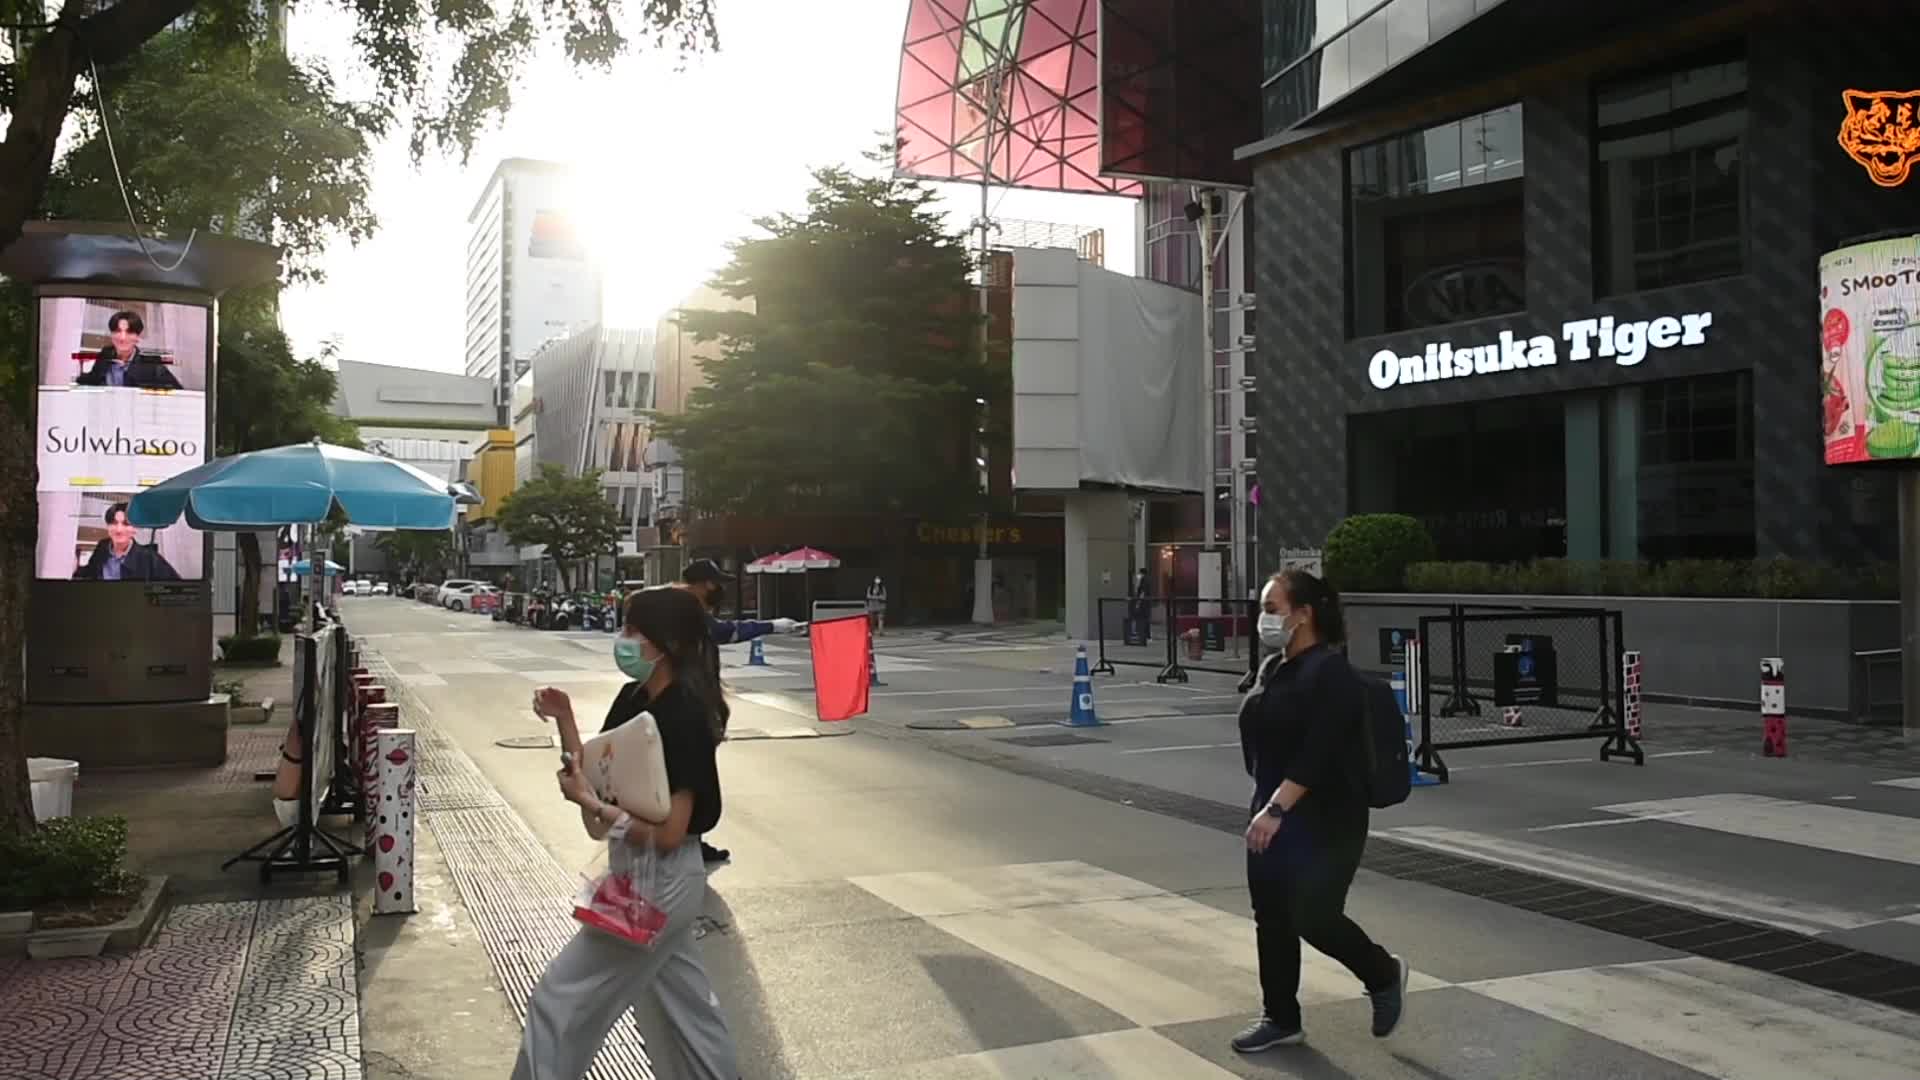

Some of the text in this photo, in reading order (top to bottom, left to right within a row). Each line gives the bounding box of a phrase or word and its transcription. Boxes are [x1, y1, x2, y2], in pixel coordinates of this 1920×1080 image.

[1368, 311, 1712, 390] Onitsuka Tiger
[46, 426, 198, 457] Sulwhasoo
